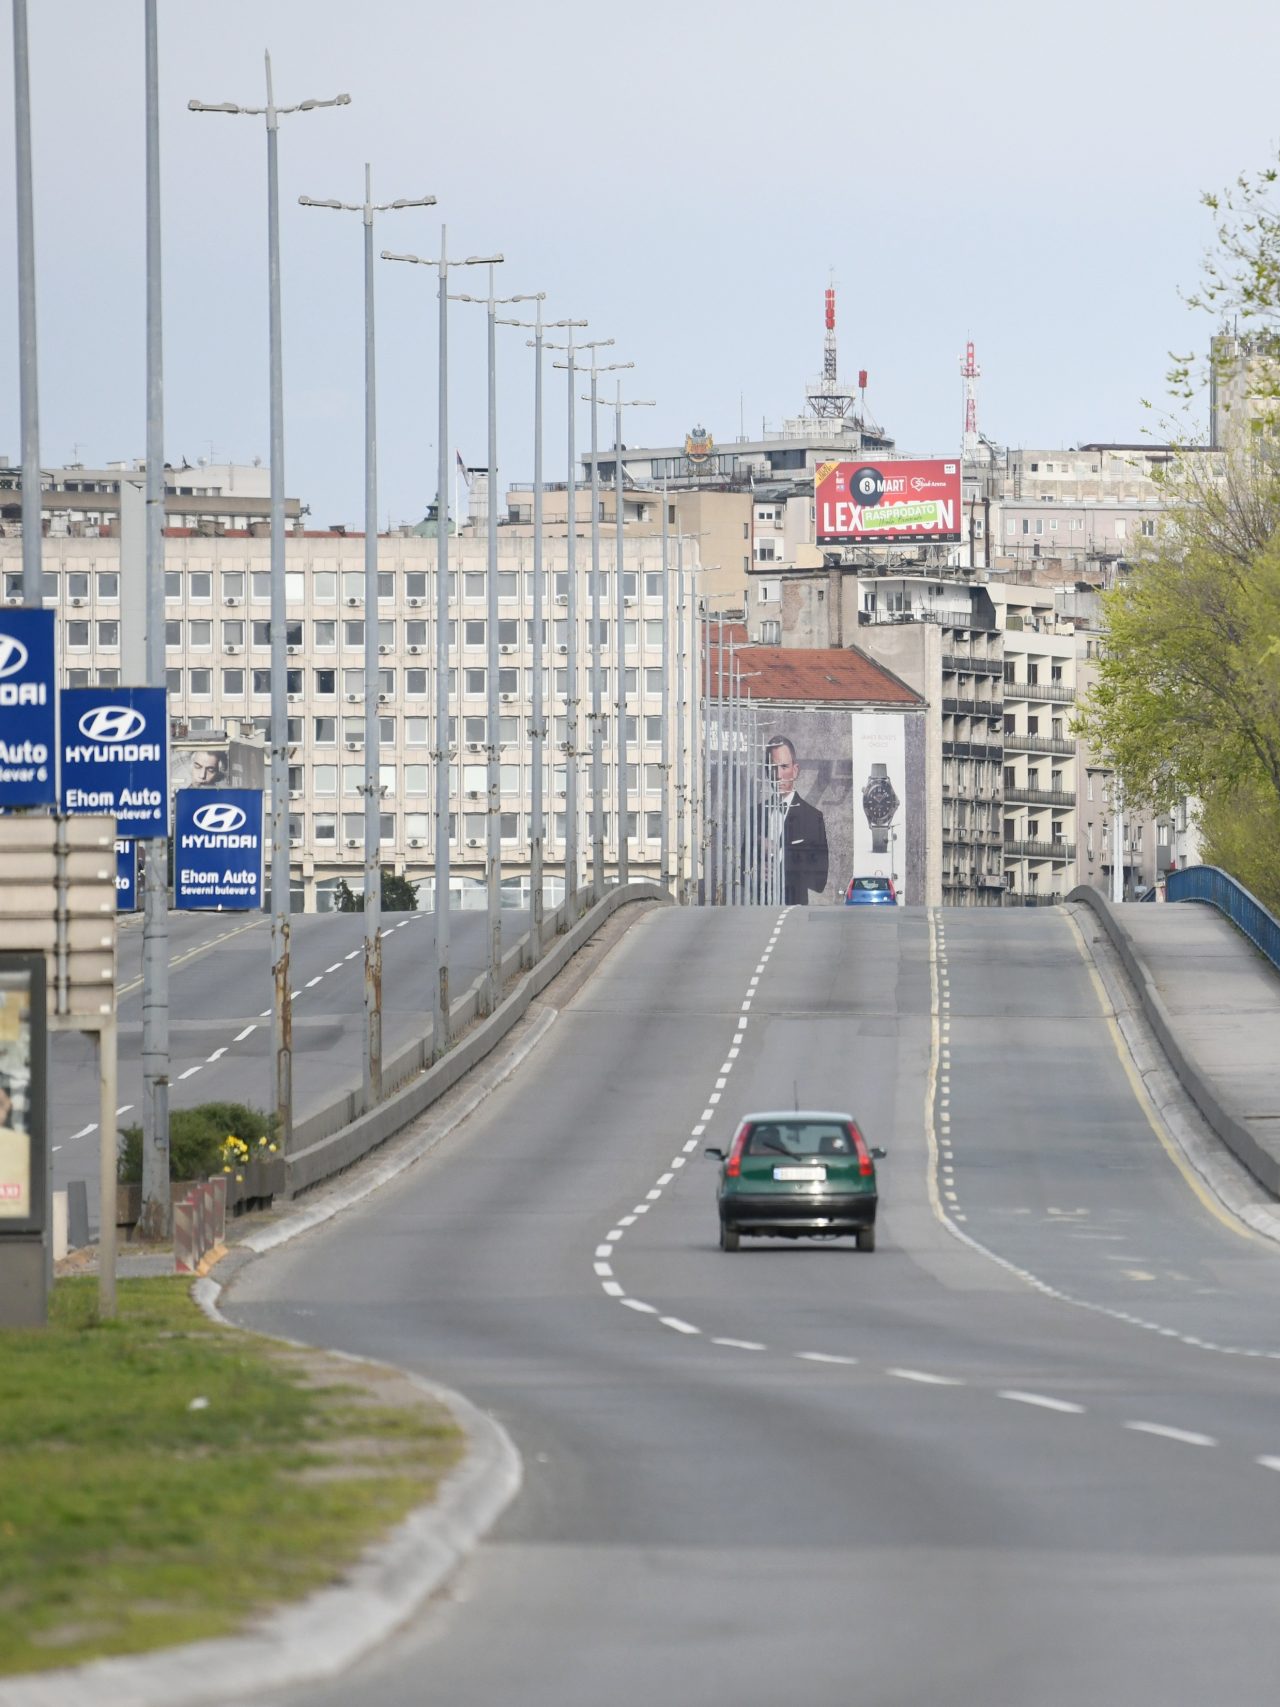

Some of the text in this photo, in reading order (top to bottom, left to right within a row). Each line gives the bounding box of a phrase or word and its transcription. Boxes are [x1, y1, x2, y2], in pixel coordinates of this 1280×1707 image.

[876, 479, 904, 493] MART
[865, 504, 935, 520] RASPRODATO
[65, 744, 161, 763] HYUNDAI
[36, 765, 48, 783] 6
[65, 787, 162, 808] Ehom Auto
[152, 807, 162, 820] 6
[181, 834, 258, 849] HYUNDAI
[180, 869, 257, 884] Ehom Auto
[180, 885, 257, 896] Severni bulevar 6
